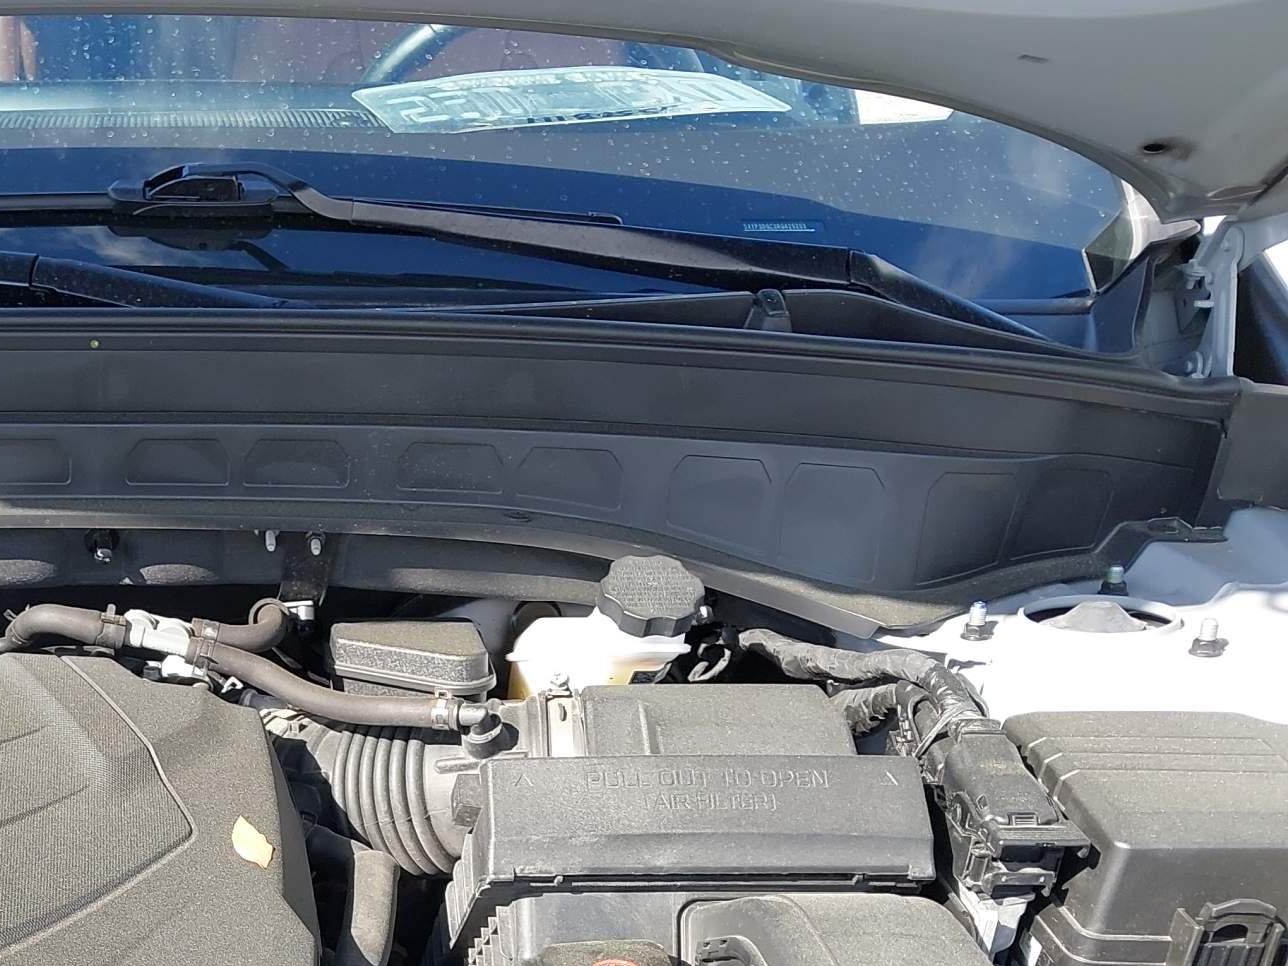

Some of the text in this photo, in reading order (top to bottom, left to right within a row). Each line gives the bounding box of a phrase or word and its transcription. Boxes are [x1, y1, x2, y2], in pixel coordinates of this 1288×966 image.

[585, 768, 830, 789] PULL OUT TO OPEN
